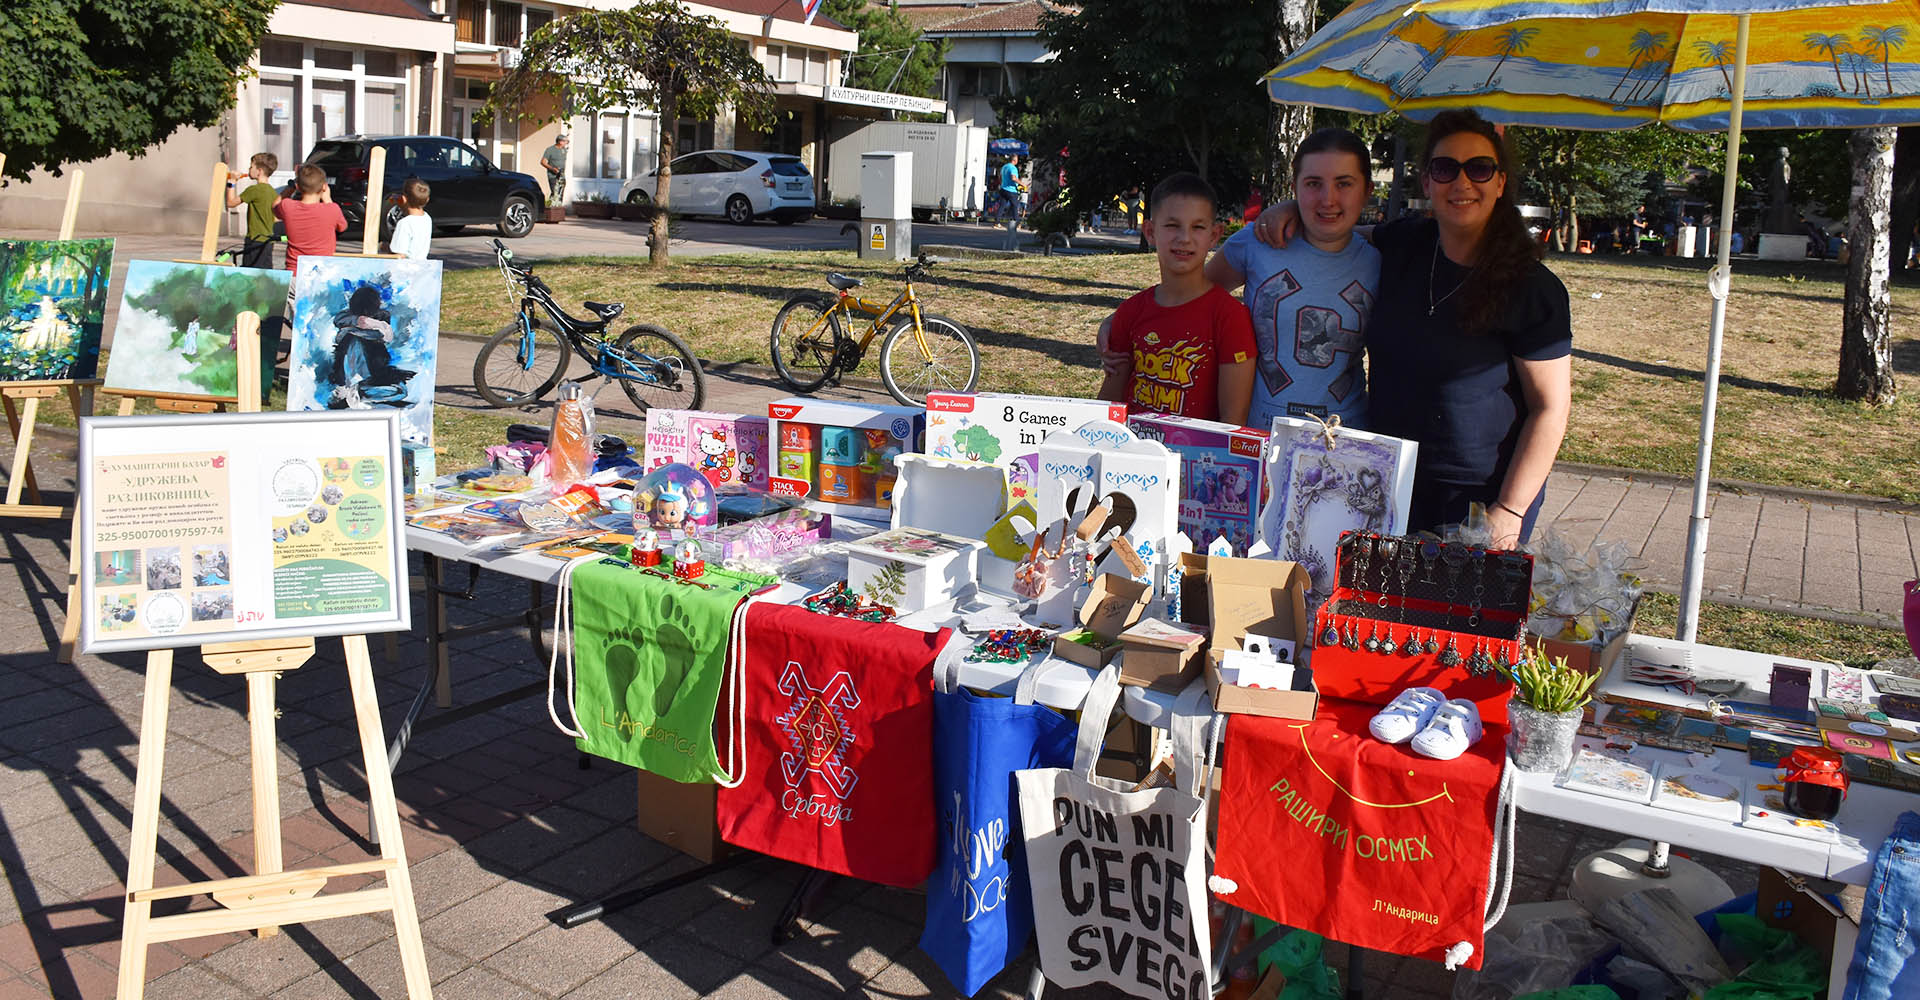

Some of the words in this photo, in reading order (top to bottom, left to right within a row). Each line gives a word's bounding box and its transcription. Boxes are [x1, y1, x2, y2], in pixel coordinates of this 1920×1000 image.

[832, 89, 870, 102] КУЛТУРНИ
[871, 94, 898, 105] ЦЕНТАР
[900, 98, 932, 110] ПЕЋИНЦИ
[1003, 406, 1014, 422] 8
[1019, 411, 1067, 427] Games
[648, 433, 686, 448] PUZZLE
[1020, 428, 1036, 444] in
[1240, 441, 1259, 453] Trefl
[773, 481, 795, 491] STACK
[1186, 507, 1196, 518] in
[782, 789, 853, 827] Србија
[1053, 797, 1118, 844] PUN
[1131, 814, 1173, 852] MI
[1270, 778, 1349, 850] РАШИРИ
[1356, 835, 1434, 862] ОСМЕХ
[1059, 839, 1199, 958] CEGE
[1372, 899, 1440, 925] Л'Андарица
